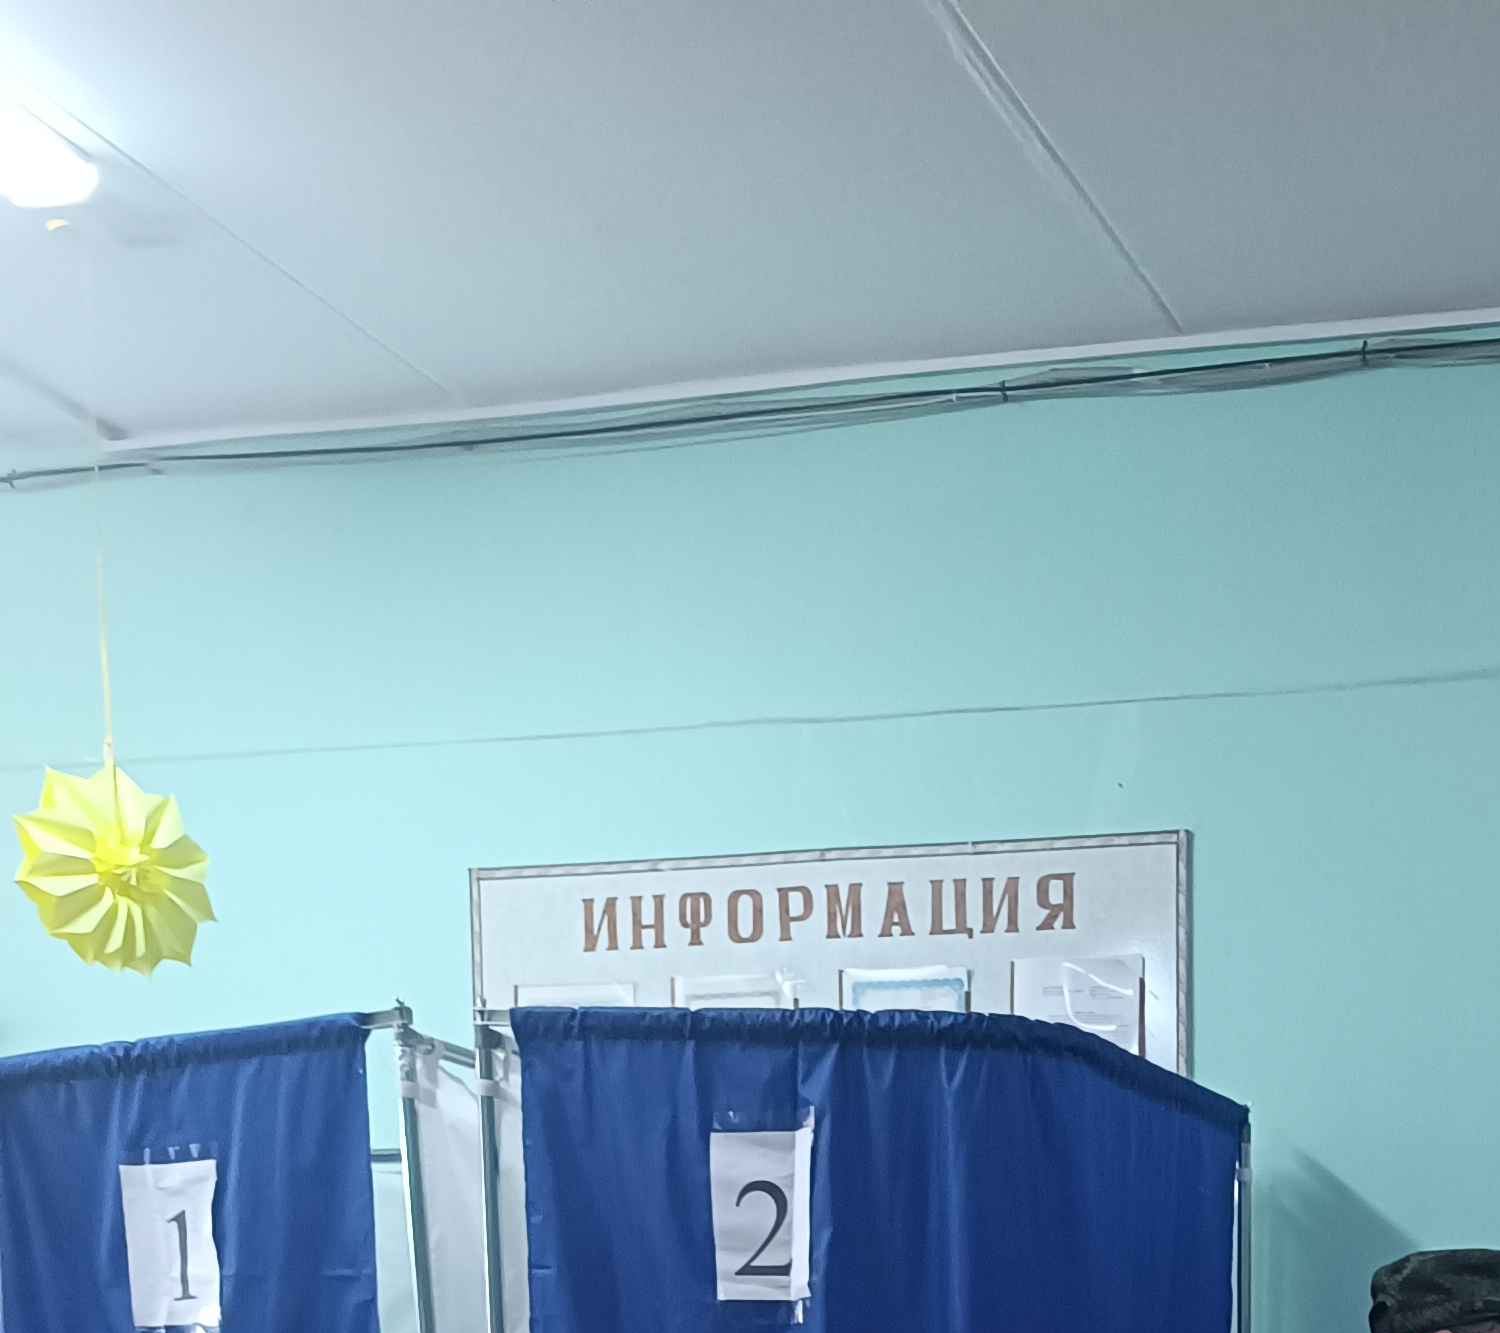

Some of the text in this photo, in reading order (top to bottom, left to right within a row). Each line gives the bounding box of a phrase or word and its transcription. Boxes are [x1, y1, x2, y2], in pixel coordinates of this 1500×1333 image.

[581, 871, 1077, 952] ИНФОРМАЦИЯ
[166, 1210, 197, 1301] 1
[735, 1180, 792, 1276] 2
